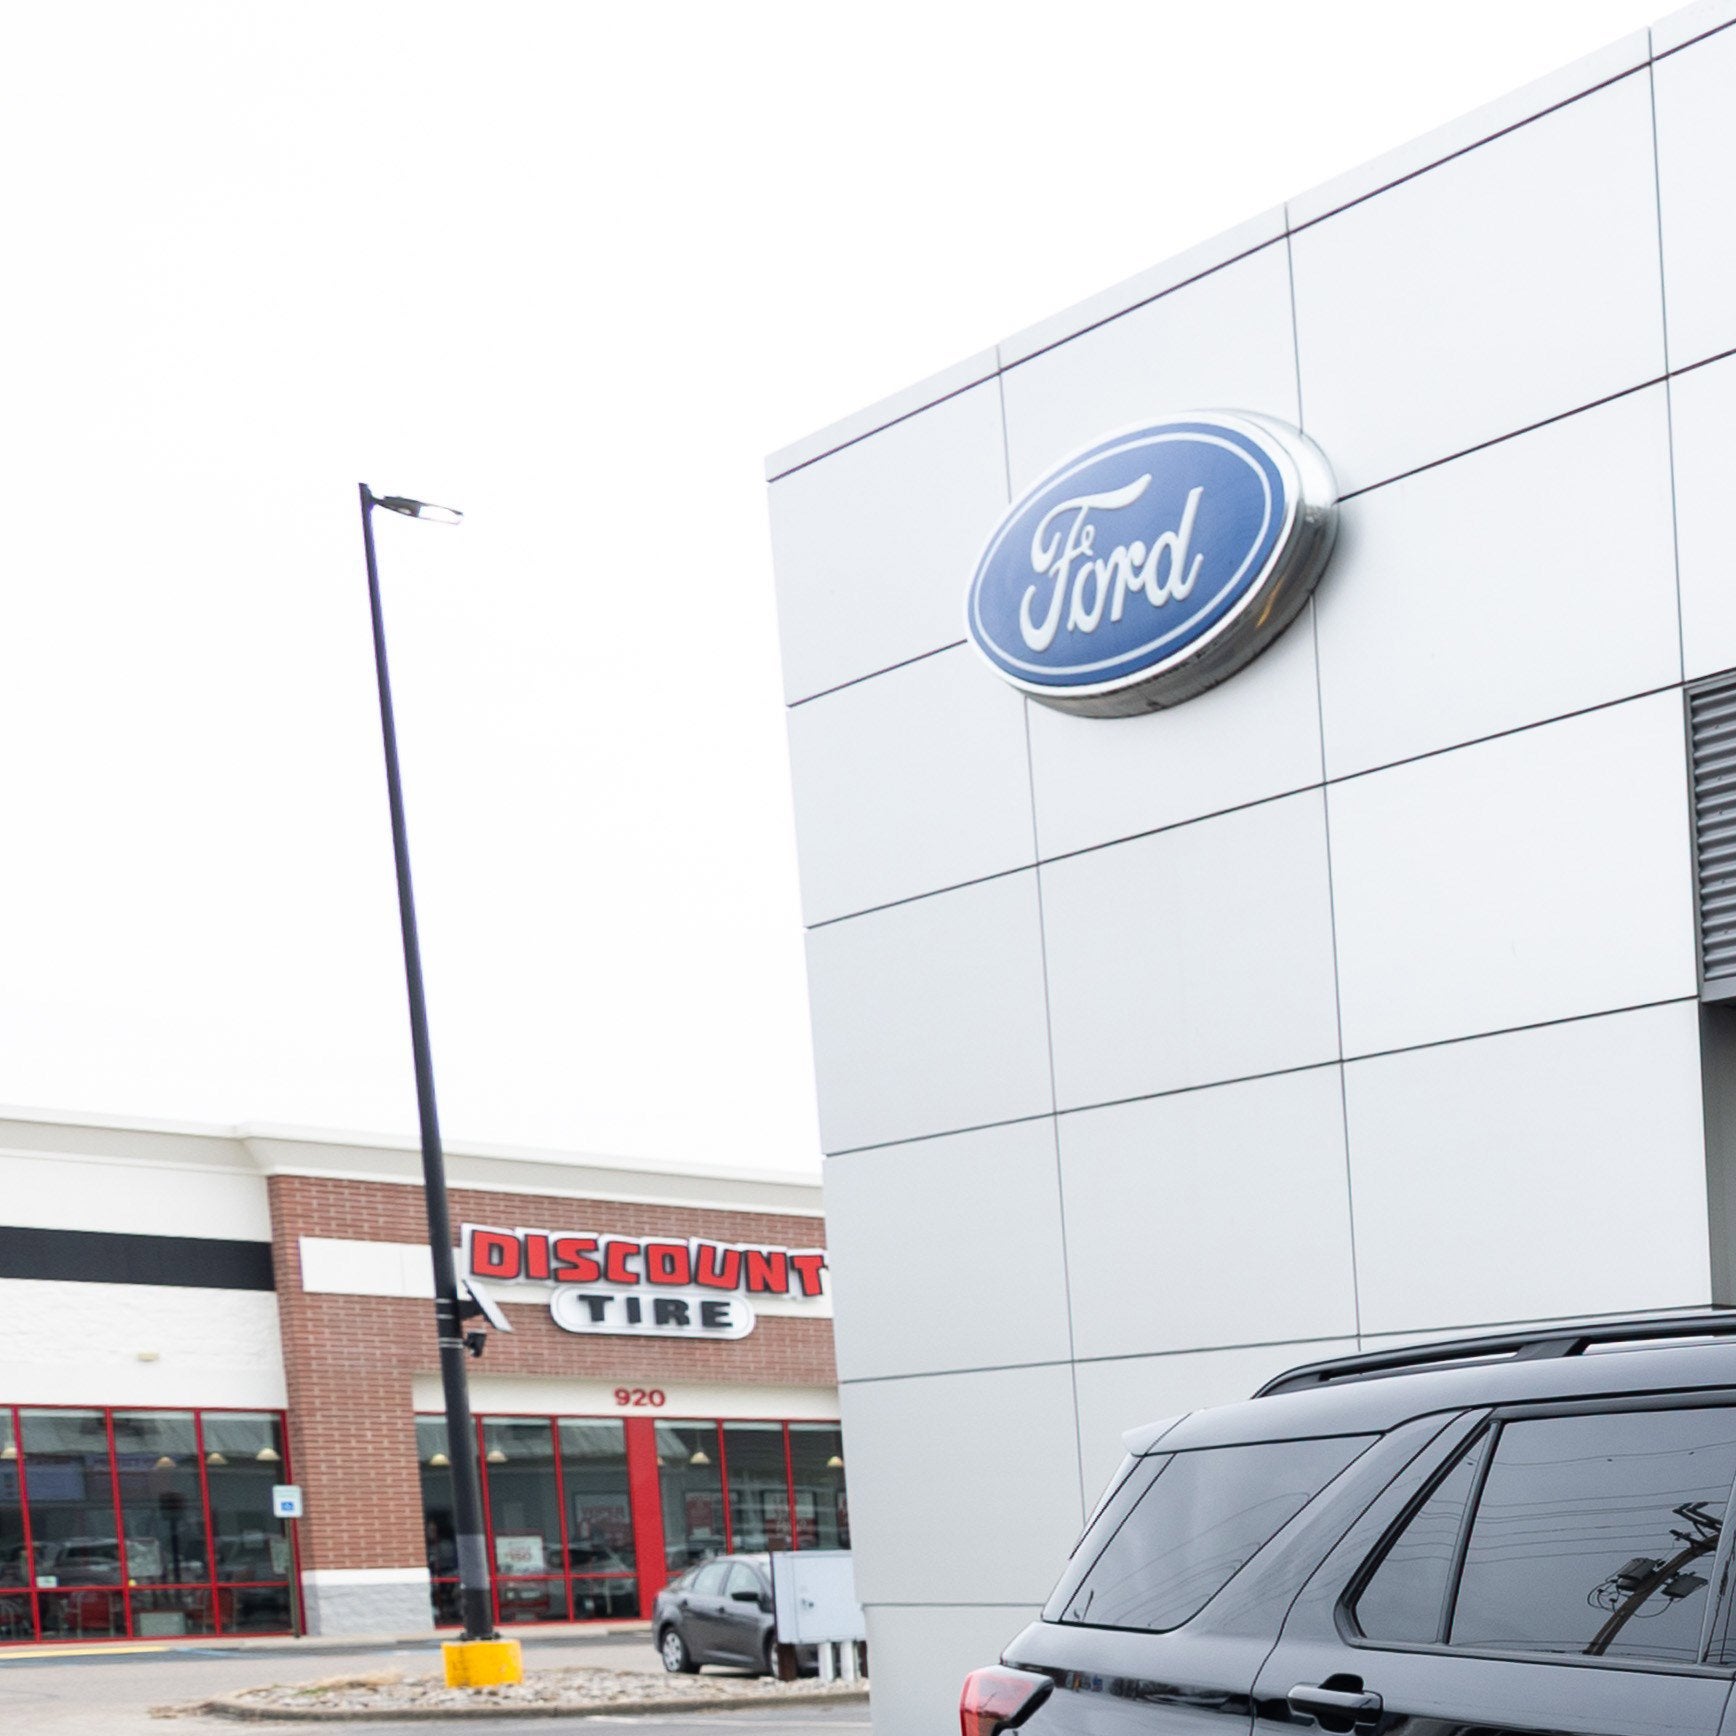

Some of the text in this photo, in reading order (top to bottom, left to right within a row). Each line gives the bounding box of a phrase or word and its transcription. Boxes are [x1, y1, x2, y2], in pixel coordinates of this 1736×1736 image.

[1019, 473, 1204, 652] Ford
[471, 1229, 825, 1297] DISCOUNT
[577, 1294, 734, 1328] TIRE
[614, 1388, 666, 1408] 920
